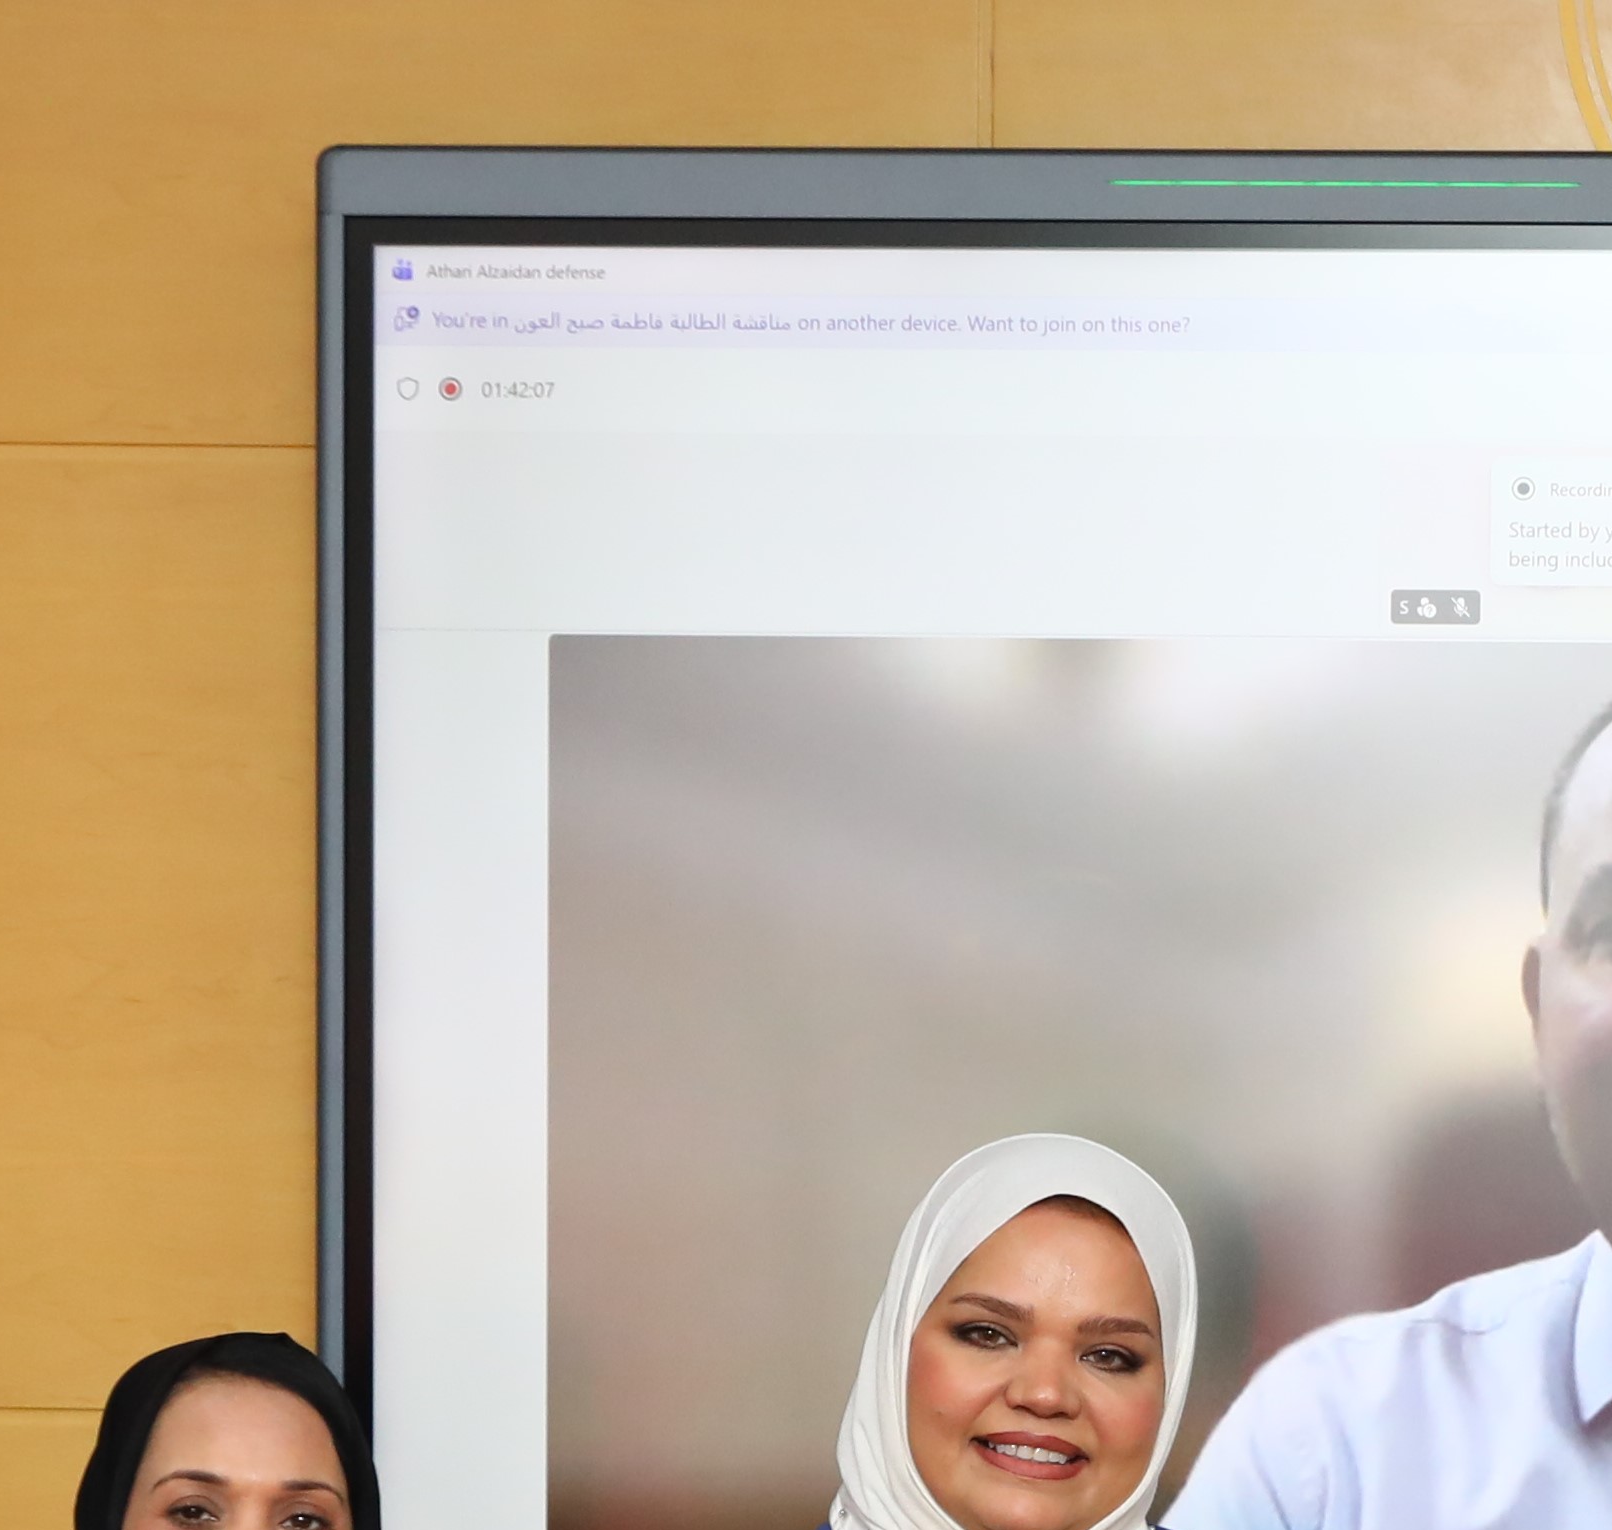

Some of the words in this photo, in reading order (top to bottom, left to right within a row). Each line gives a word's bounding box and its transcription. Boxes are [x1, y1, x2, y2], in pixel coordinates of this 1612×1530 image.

[477, 265, 541, 279] Alzaidan
[546, 265, 605, 279] defense
[432, 312, 487, 329] You're
[492, 312, 509, 328] in
[798, 317, 820, 331] on
[826, 314, 895, 331] another
[901, 314, 961, 332] device.
[967, 315, 1013, 332] Want
[1019, 317, 1038, 332] to
[1042, 316, 1076, 336] join
[1082, 319, 1105, 332] on
[1111, 316, 1142, 333] this
[1148, 316, 1191, 333] one?
[481, 382, 555, 398] 01:42:07
[1508, 522, 1573, 540] Started
[1578, 523, 1600, 544] by
[1509, 551, 1559, 571] being
[1399, 600, 1409, 615] S
